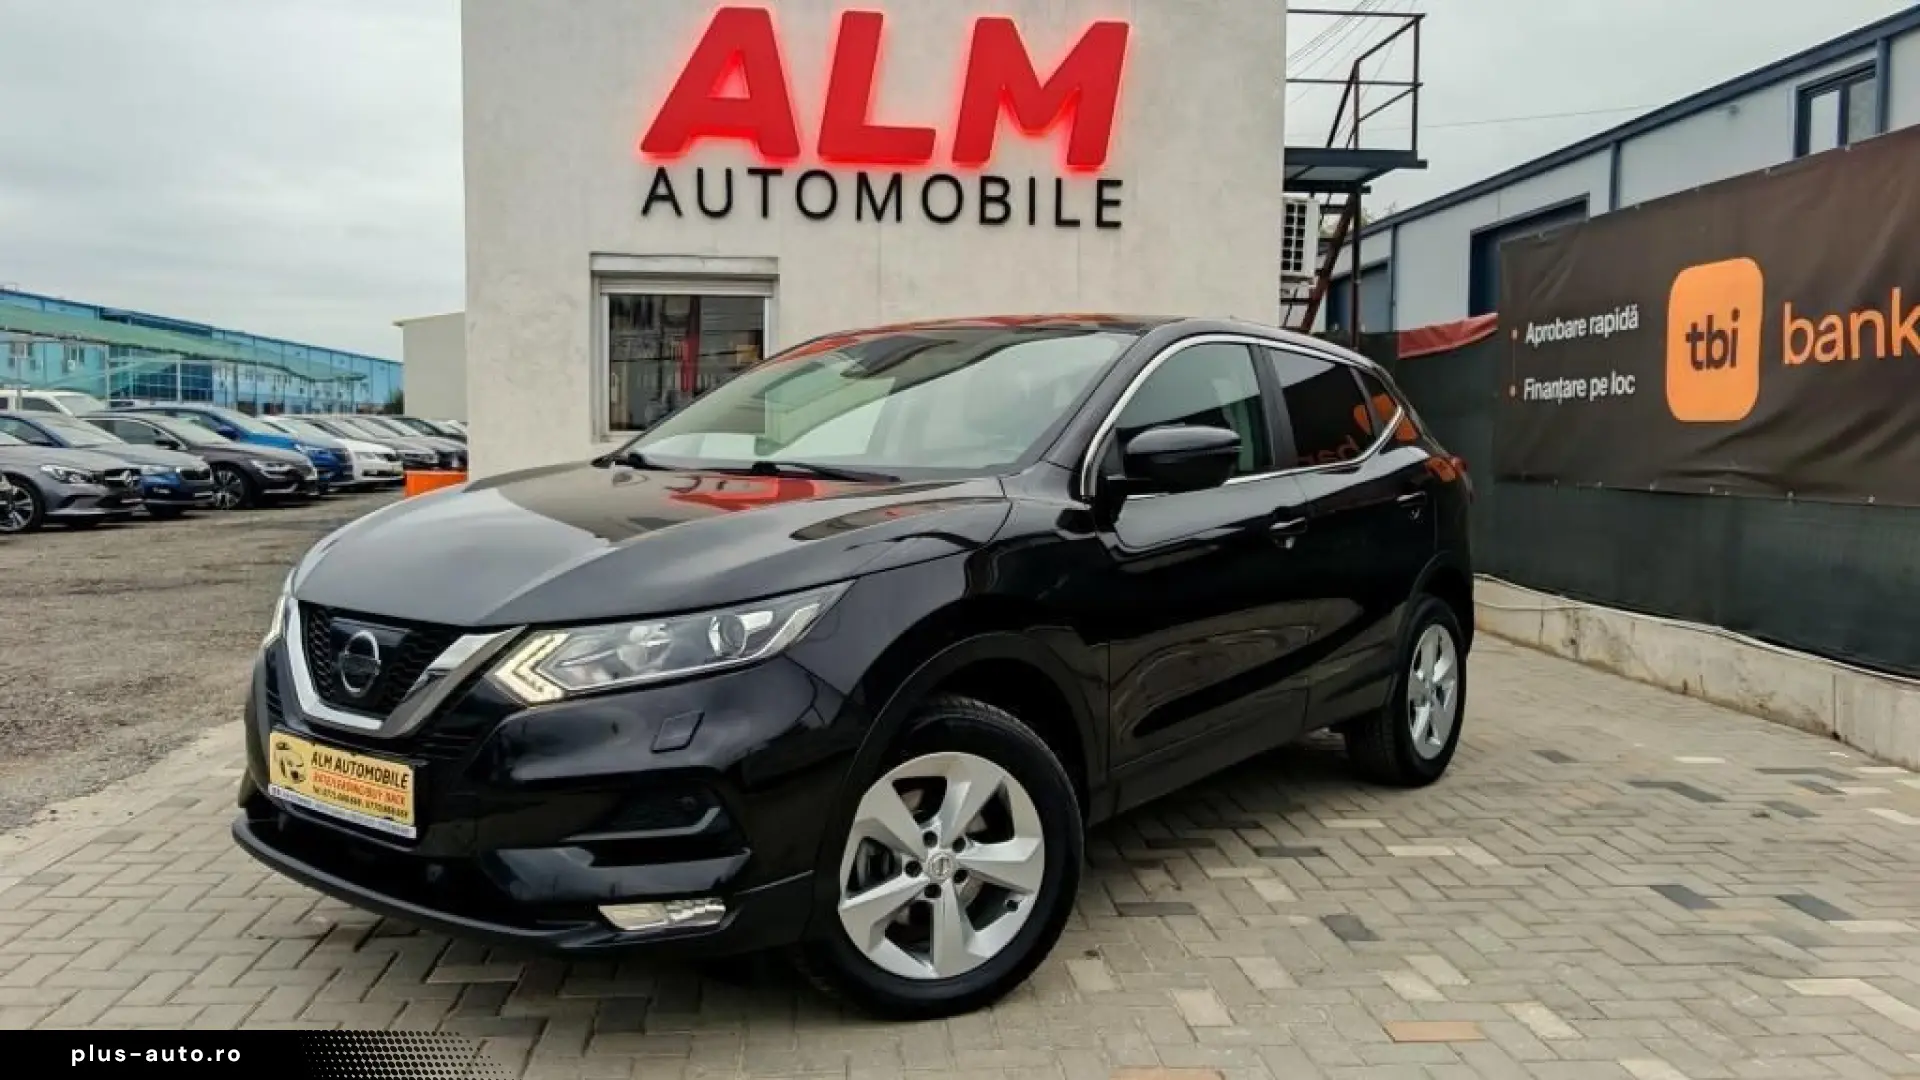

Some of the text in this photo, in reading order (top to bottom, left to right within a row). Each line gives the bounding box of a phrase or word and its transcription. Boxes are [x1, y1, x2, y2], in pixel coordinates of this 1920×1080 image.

[639, 6, 1130, 169] ALM
[641, 166, 1124, 229] AUTOMOBILE
[1525, 303, 1640, 348] Aprobare rapidă
[1685, 286, 1920, 371] tbi bank
[1589, 376, 1608, 402] pe
[1610, 368, 1636, 396] loc
[311, 751, 409, 790] ALM AUTOMOBILE
